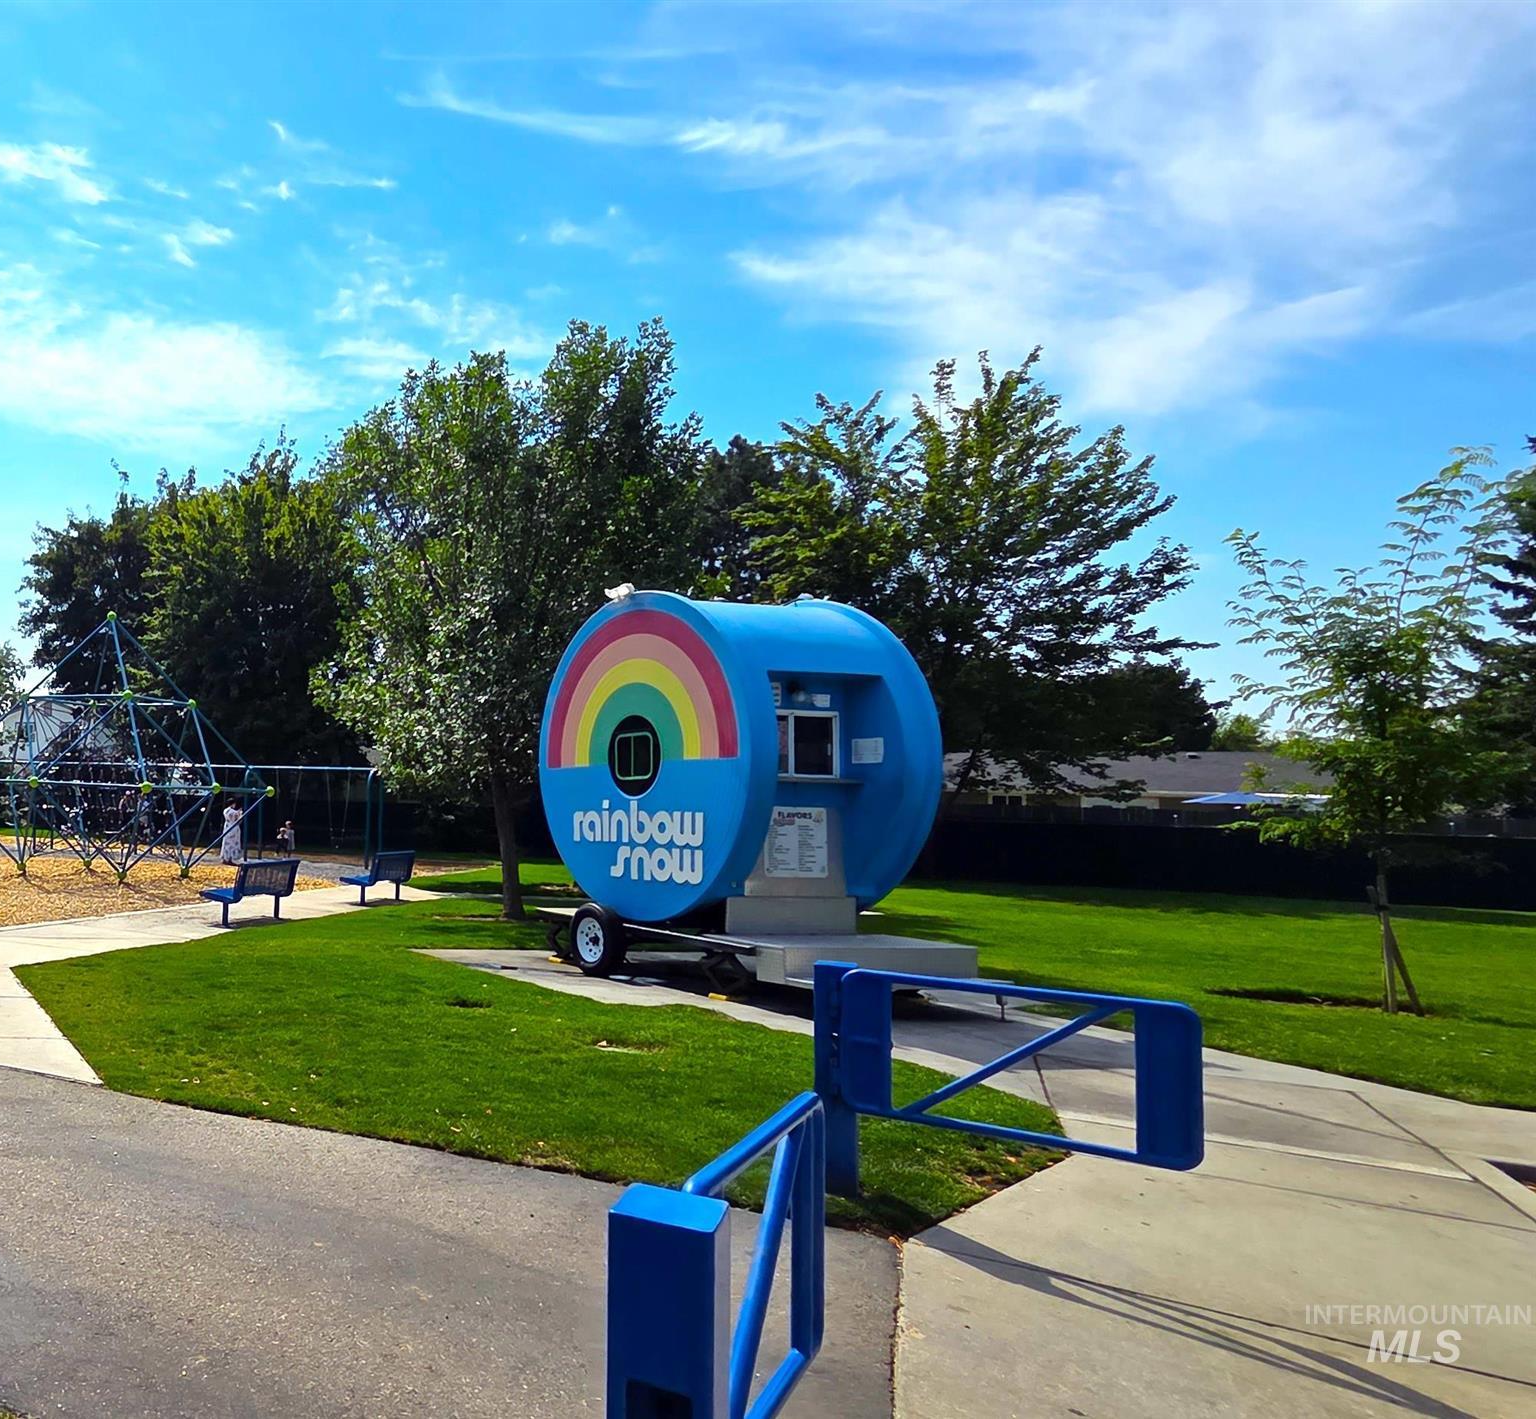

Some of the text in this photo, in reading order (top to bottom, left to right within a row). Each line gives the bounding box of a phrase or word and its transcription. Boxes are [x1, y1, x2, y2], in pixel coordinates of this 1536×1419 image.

[573, 799, 704, 847] rainbow
[777, 811, 813, 819] FLAVORS
[610, 845, 703, 884] snow
